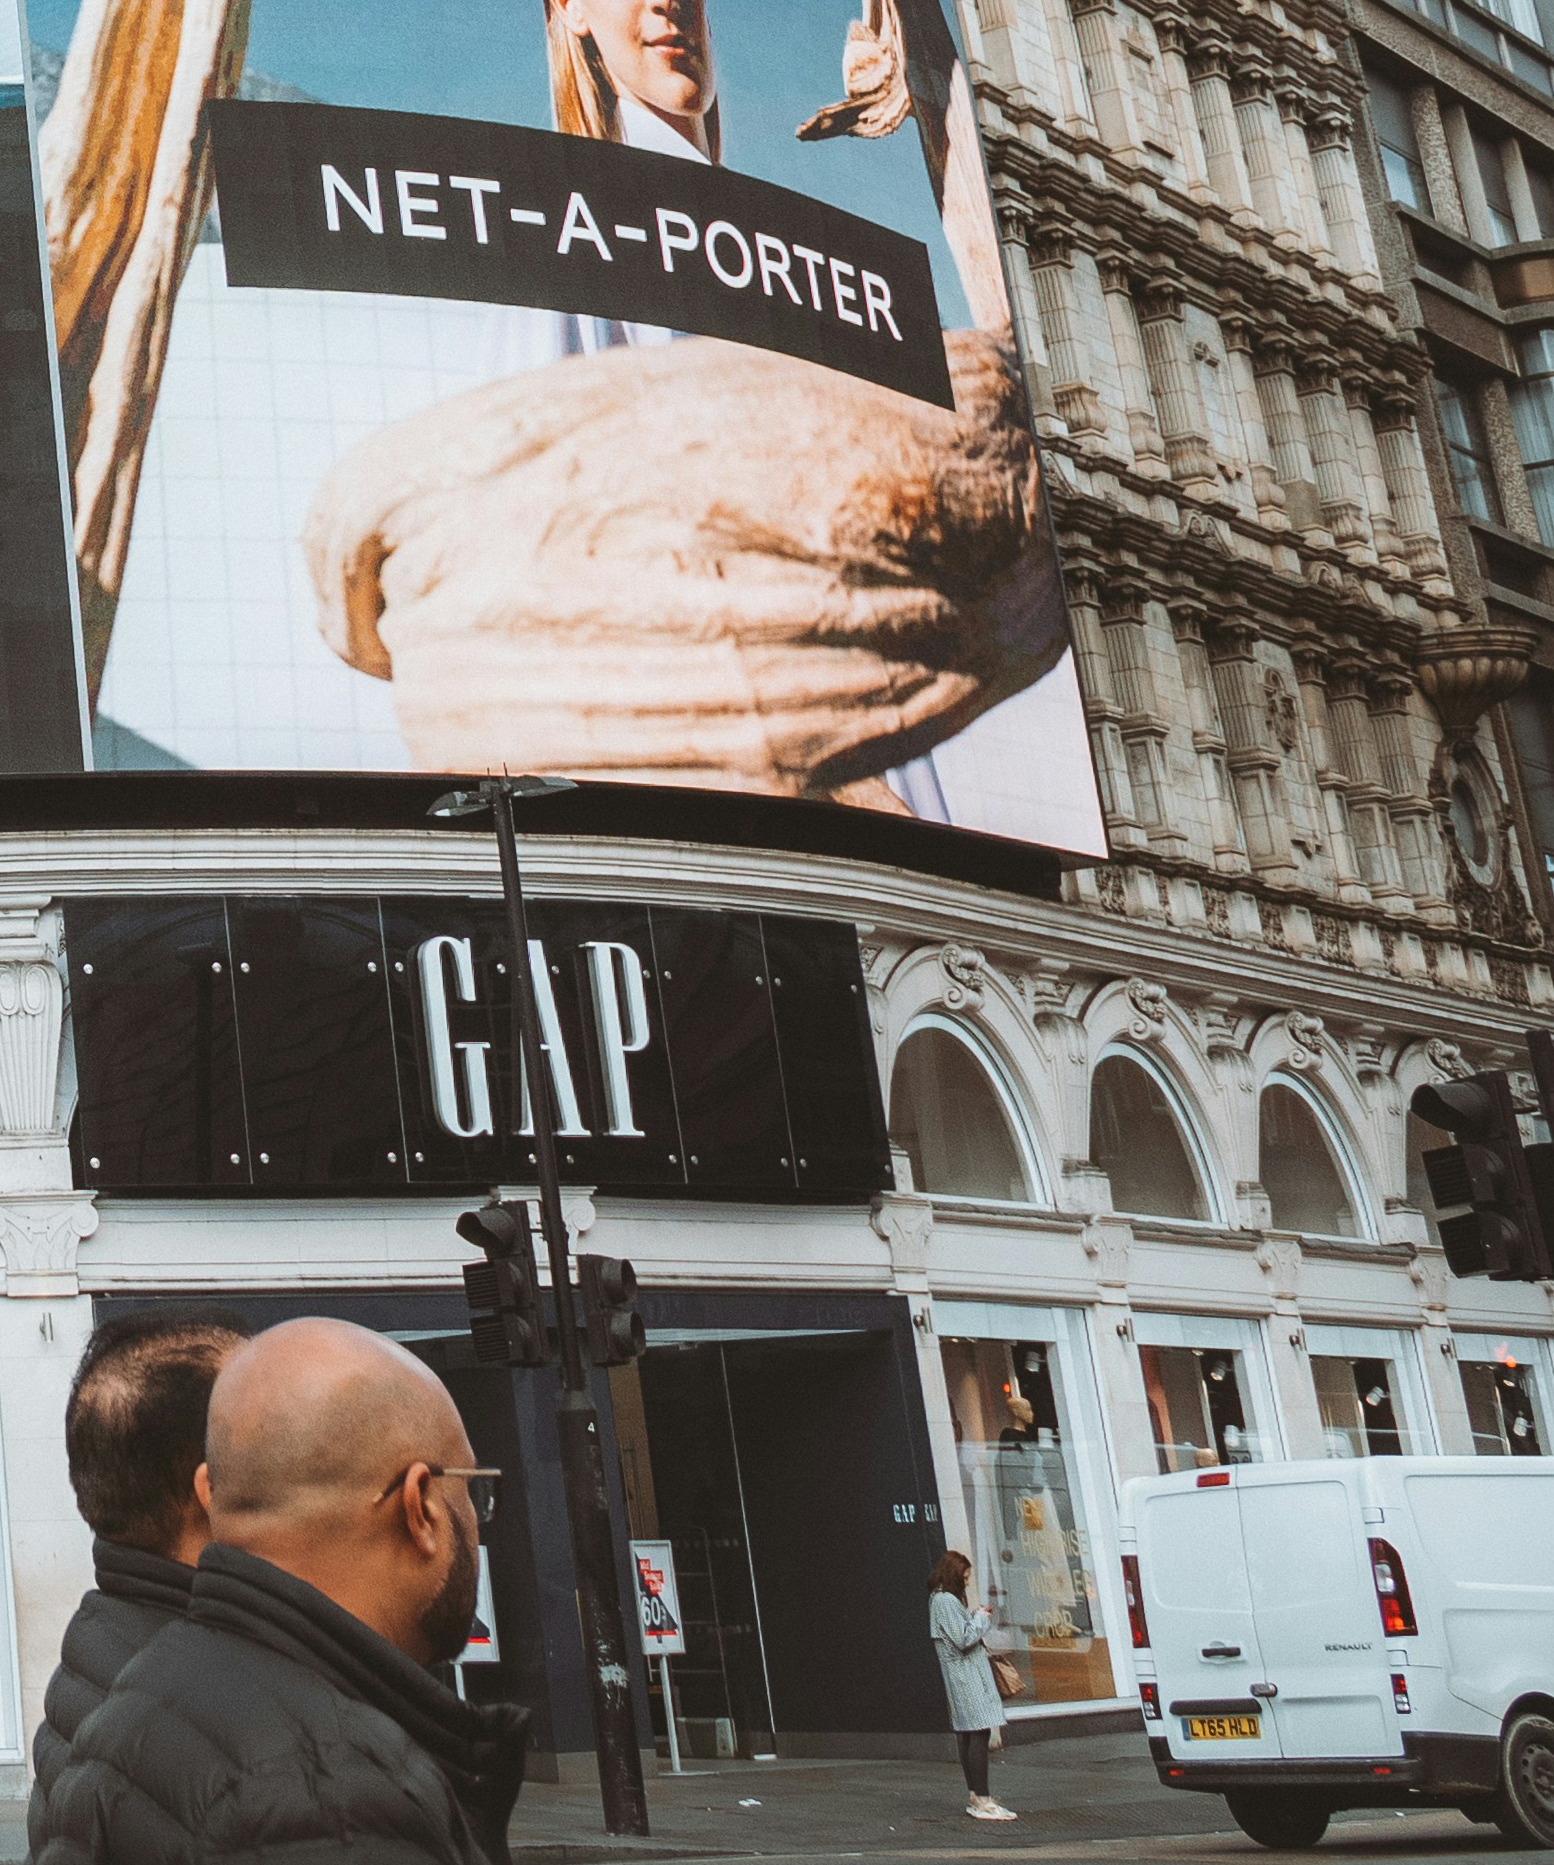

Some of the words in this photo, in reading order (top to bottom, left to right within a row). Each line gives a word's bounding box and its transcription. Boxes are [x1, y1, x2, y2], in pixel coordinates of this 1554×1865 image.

[320, 163, 903, 341] NET-A-PORTER
[413, 935, 651, 1138] GAP
[587, 1421, 596, 1433] 4
[893, 1503, 916, 1523] GAP
[642, 1596, 661, 1627] 60
[1324, 1642, 1373, 1652] RENAULT
[1189, 1718, 1226, 1737] LT65
[1229, 1717, 1258, 1736] HLD
